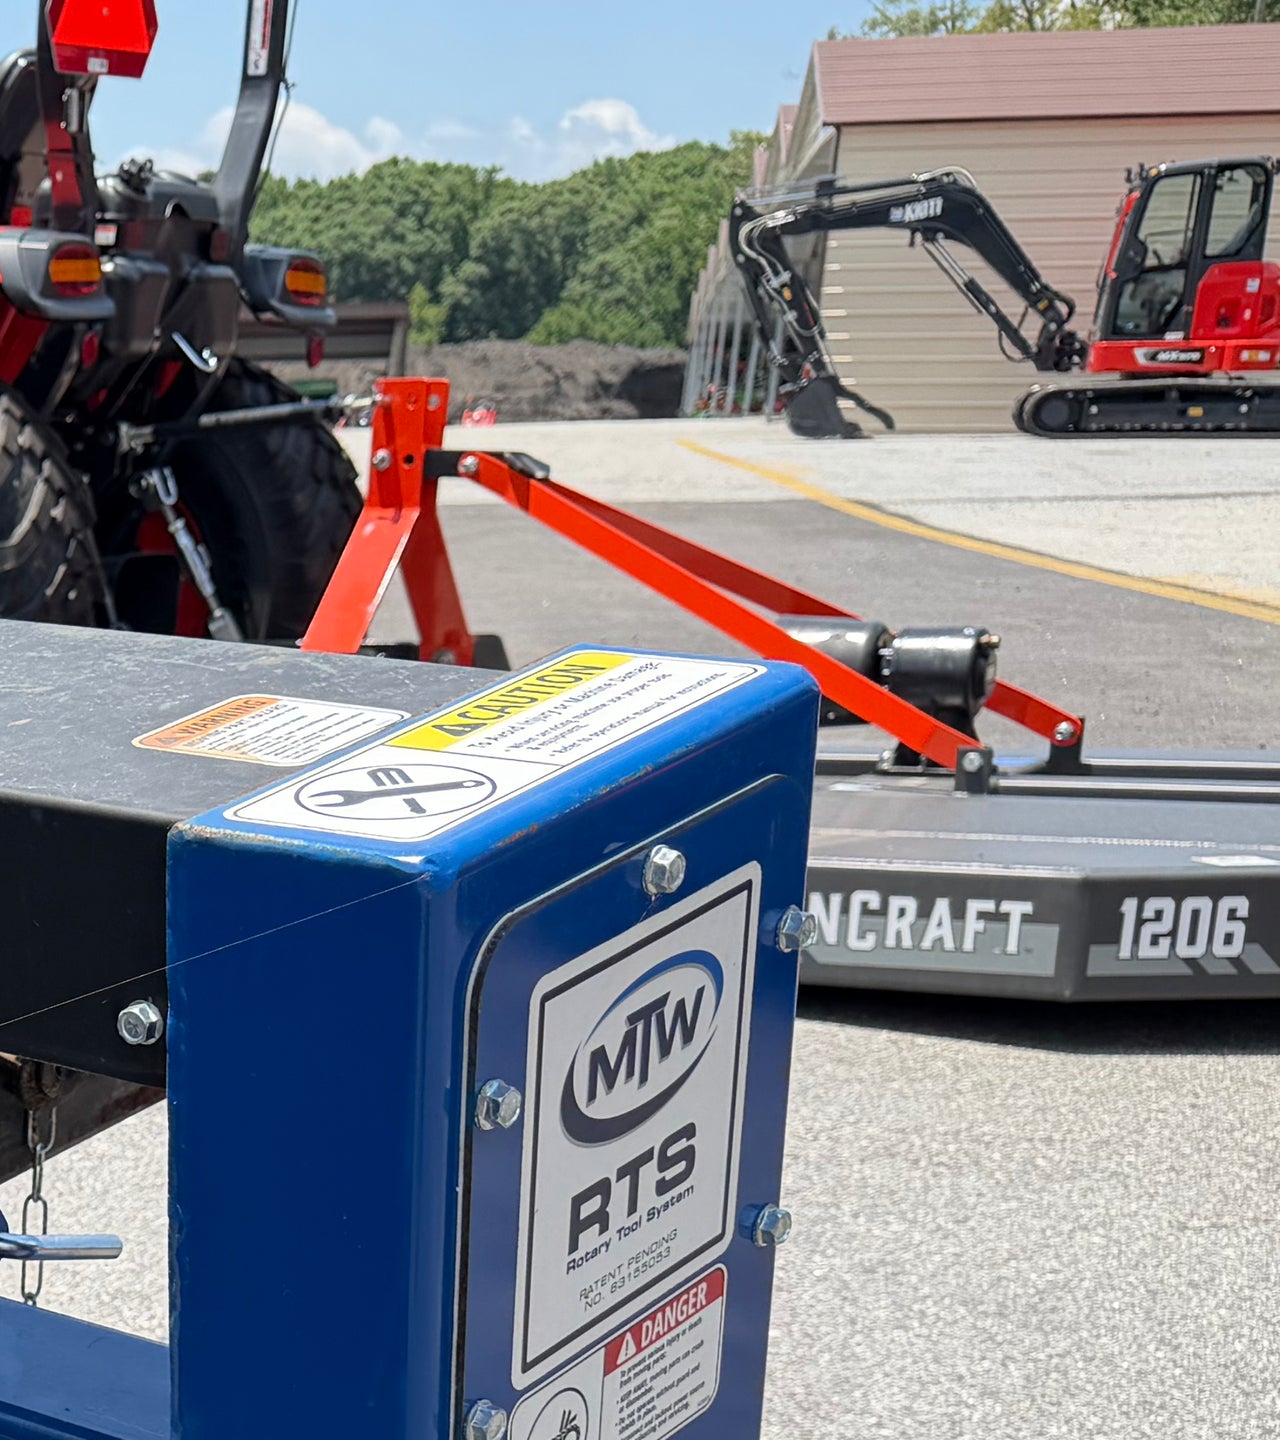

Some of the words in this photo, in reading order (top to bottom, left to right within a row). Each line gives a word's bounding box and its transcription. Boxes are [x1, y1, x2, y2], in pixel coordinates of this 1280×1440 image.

[468, 664, 606, 722] CAUTION
[1118, 895, 1251, 960] 1206
[586, 985, 706, 1108] MTW
[568, 1121, 697, 1256] RTS
[566, 1237, 612, 1275] Rotary
[616, 1215, 642, 1242] Tool
[646, 1185, 694, 1222] System
[580, 1264, 624, 1302] PATENT
[627, 1228, 678, 1269] PENDING
[584, 1292, 605, 1312] NO.
[641, 1281, 708, 1348] DANGER
